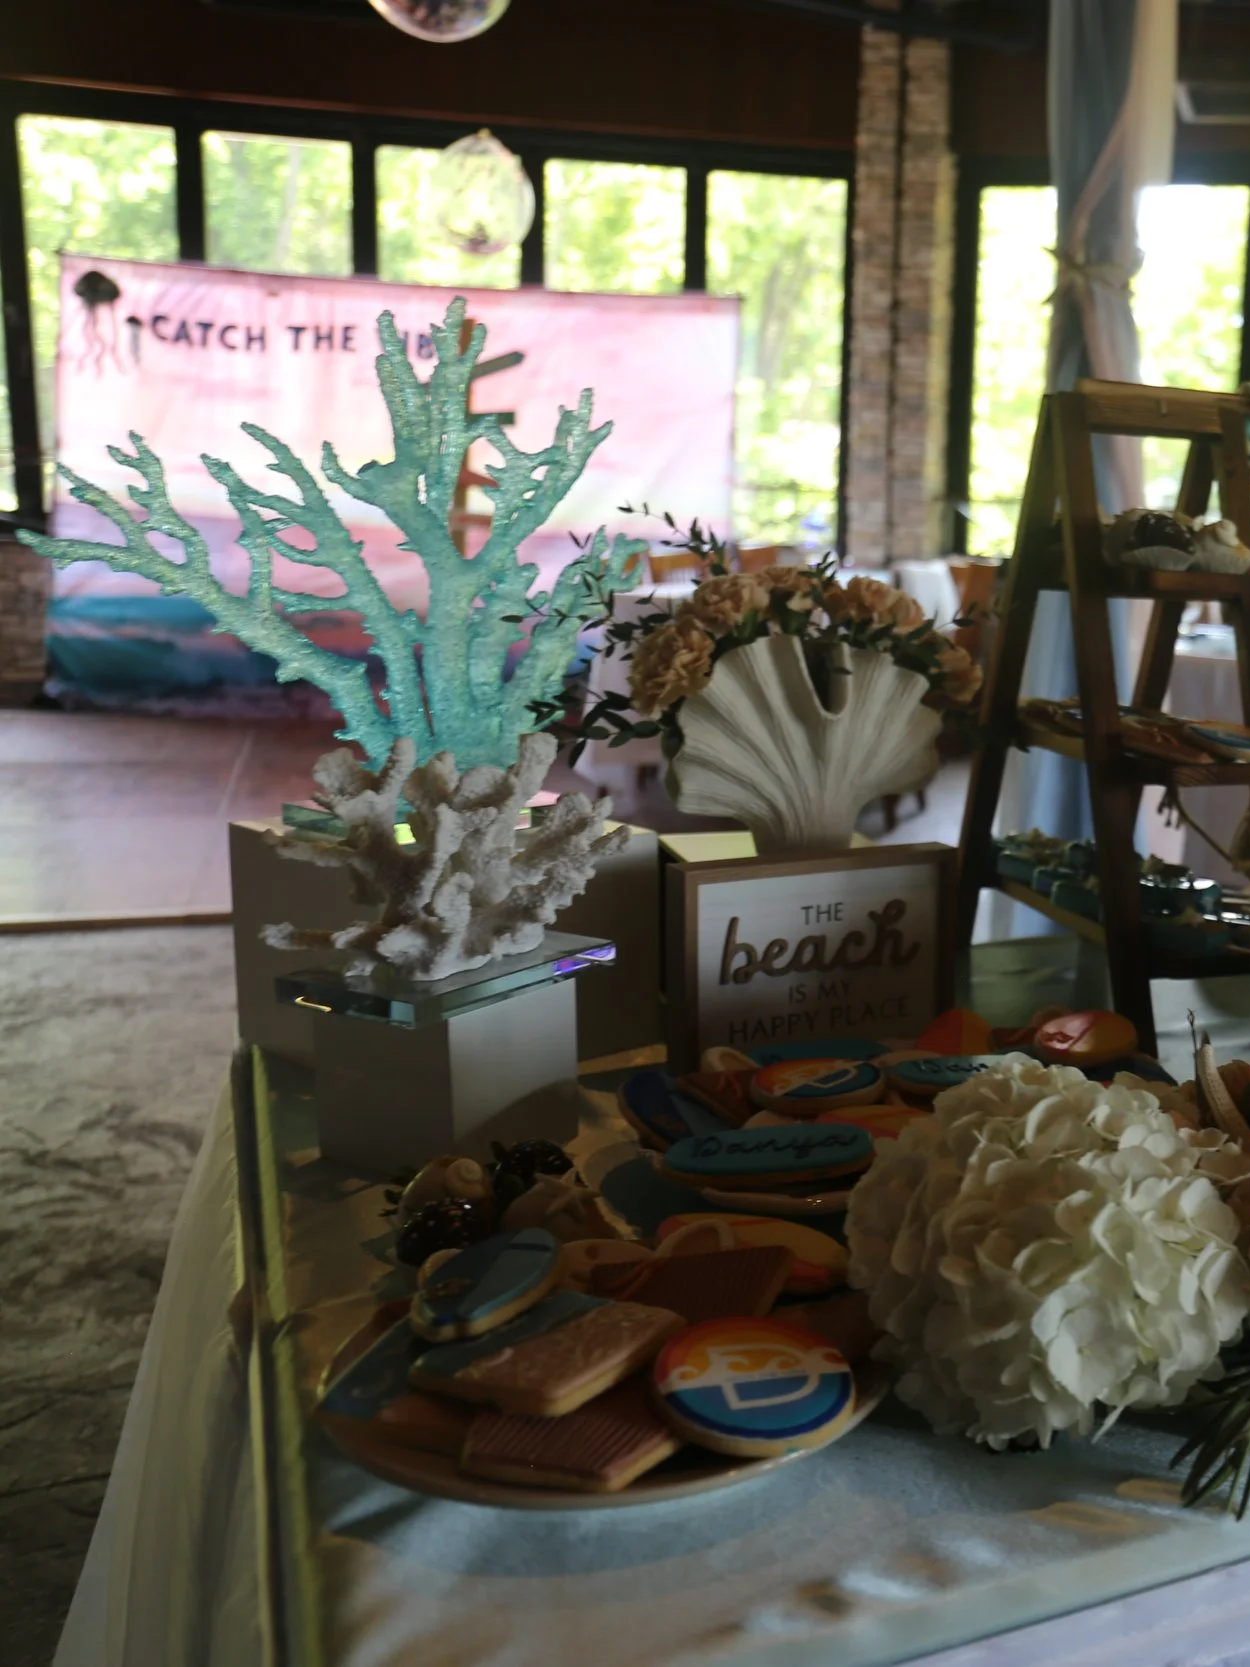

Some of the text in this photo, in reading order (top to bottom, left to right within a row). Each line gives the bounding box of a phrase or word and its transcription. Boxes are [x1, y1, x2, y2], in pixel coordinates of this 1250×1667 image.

[152, 315, 266, 351] CATCH
[287, 325, 356, 351] THE
[801, 902, 844, 925] THE
[719, 898, 921, 985] beach
[789, 979, 851, 1004] IS MY
[729, 996, 909, 1044] HAPPY PLACE
[690, 1134, 858, 1159] Danya
